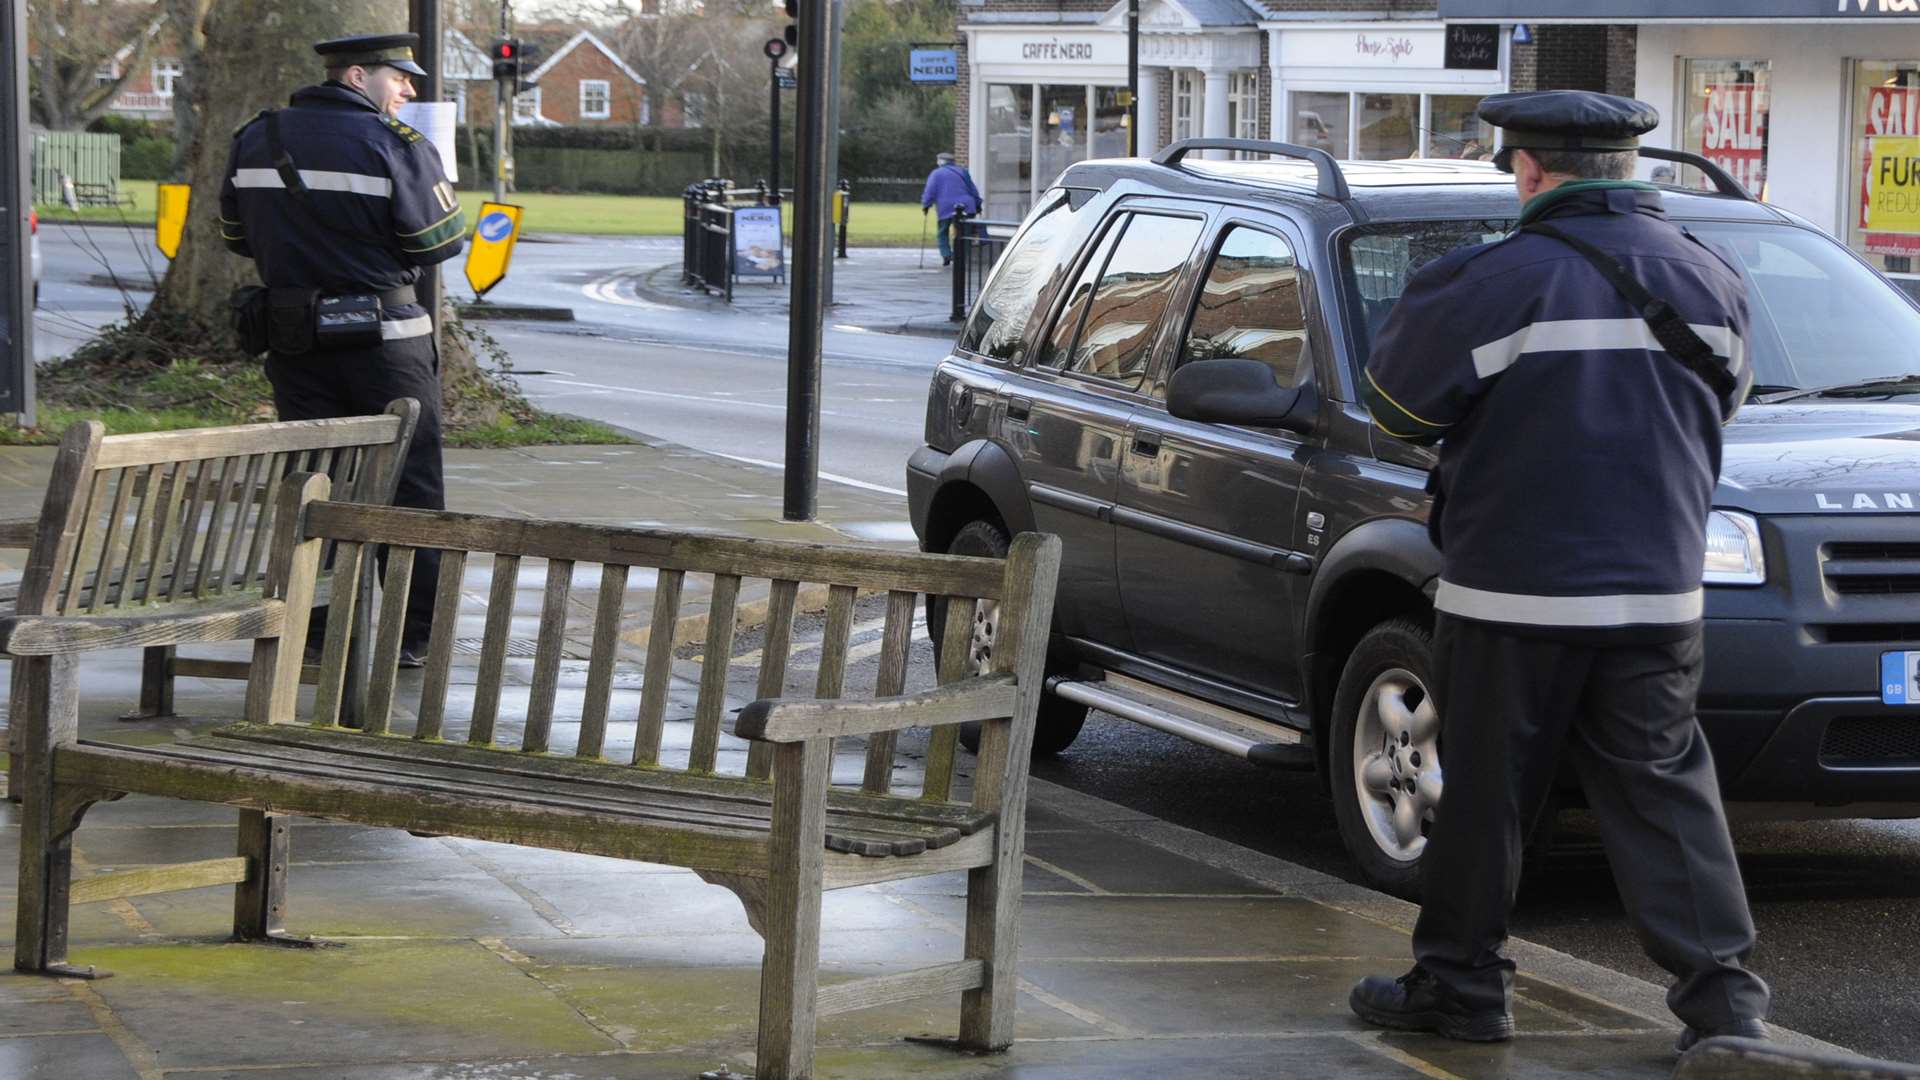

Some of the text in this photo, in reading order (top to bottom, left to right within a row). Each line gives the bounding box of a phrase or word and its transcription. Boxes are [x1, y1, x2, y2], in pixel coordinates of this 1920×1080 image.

[1059, 43, 1092, 59] NERO
[913, 66, 955, 75] NERO
[1705, 89, 1765, 150] SALE
[1815, 493, 1920, 509] LAN
[1307, 533, 1320, 546] ES
[1886, 683, 1903, 695] GB
